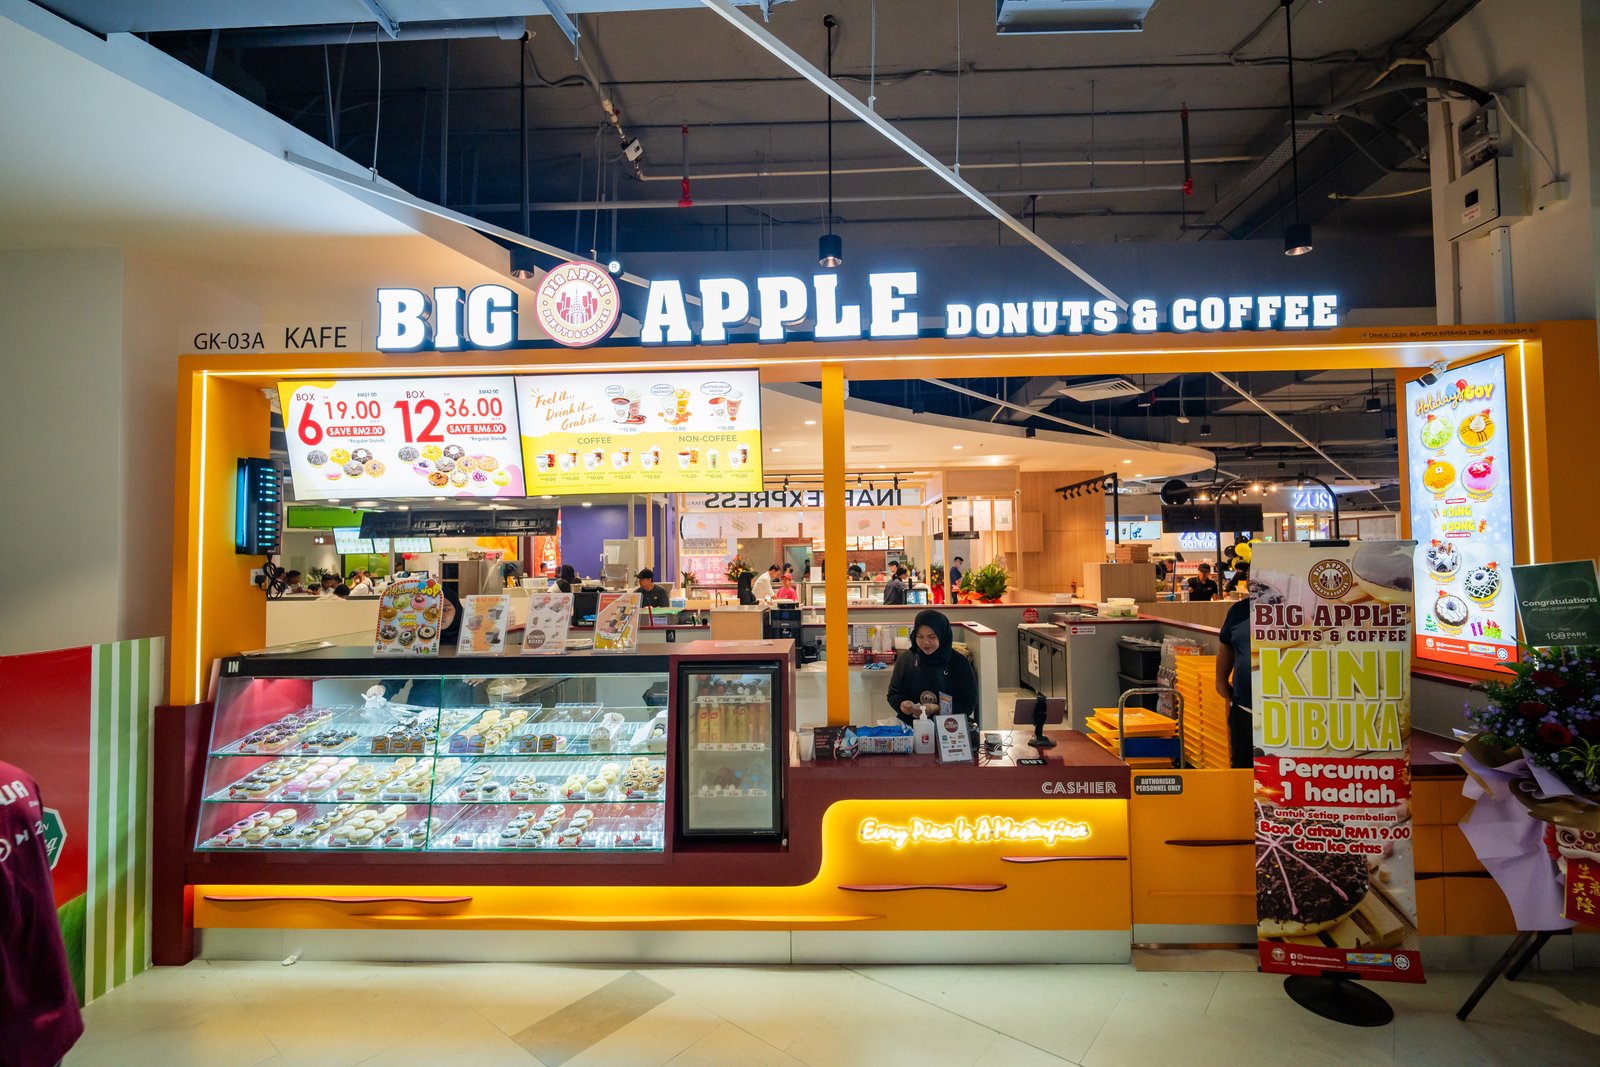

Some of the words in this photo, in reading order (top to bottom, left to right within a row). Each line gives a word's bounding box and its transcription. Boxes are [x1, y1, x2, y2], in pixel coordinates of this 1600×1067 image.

[543, 274, 566, 298] BIG
[567, 268, 611, 297] APPLE
[377, 284, 517, 350] BIG
[641, 271, 919, 343] APPLE
[945, 300, 1118, 336] DONUTS
[1132, 299, 1157, 331] &
[1172, 295, 1338, 330] COFFEE
[543, 309, 574, 338] DONUTS
[582, 308, 611, 337] COFFEE
[193, 331, 265, 350] GK-03A
[285, 326, 347, 348] KAFE
[296, 393, 315, 401] BOX
[406, 390, 426, 398] BOX
[535, 391, 556, 408] Feel
[394, 399, 444, 443] 12
[444, 397, 503, 417] 36.00
[546, 402, 574, 421] Drink
[298, 402, 323, 446] 6
[324, 400, 381, 420] 19.00
[330, 428, 351, 436] SAVE
[352, 427, 382, 435] RM2.00
[450, 425, 472, 434] SAVE
[474, 424, 504, 432] RM6.00
[561, 414, 586, 430] Grab
[1522, 596, 1598, 607] Congratulations
[1254, 604, 1303, 626] BIG
[1314, 604, 1407, 628] APPLE
[1256, 629, 1323, 642] DONUTS
[1330, 630, 1340, 642] &
[1347, 630, 1407, 642] COFFEE
[228, 661, 240, 673] IN
[1259, 648, 1404, 700] KINI
[1262, 700, 1403, 751] DIBUKA
[1278, 758, 1395, 780] Percuma
[1041, 782, 1118, 794] CASHIER
[1280, 781, 1292, 801] 1
[1304, 780, 1396, 804] hadiah
[1275, 810, 1306, 818] untuk
[1308, 810, 1340, 822] setiap
[1342, 812, 1397, 822] pembelian
[862, 818, 909, 848] Every
[912, 819, 954, 841] Piece
[976, 818, 990, 841] A
[993, 818, 1088, 846] Masterpiece
[1260, 820, 1290, 835] Box
[1292, 824, 1304, 836] 6
[1306, 825, 1342, 838] atau
[1344, 826, 1410, 840] RM19.00
[1294, 840, 1324, 852] dan
[1327, 840, 1346, 854] ke
[1349, 843, 1382, 854] atas
